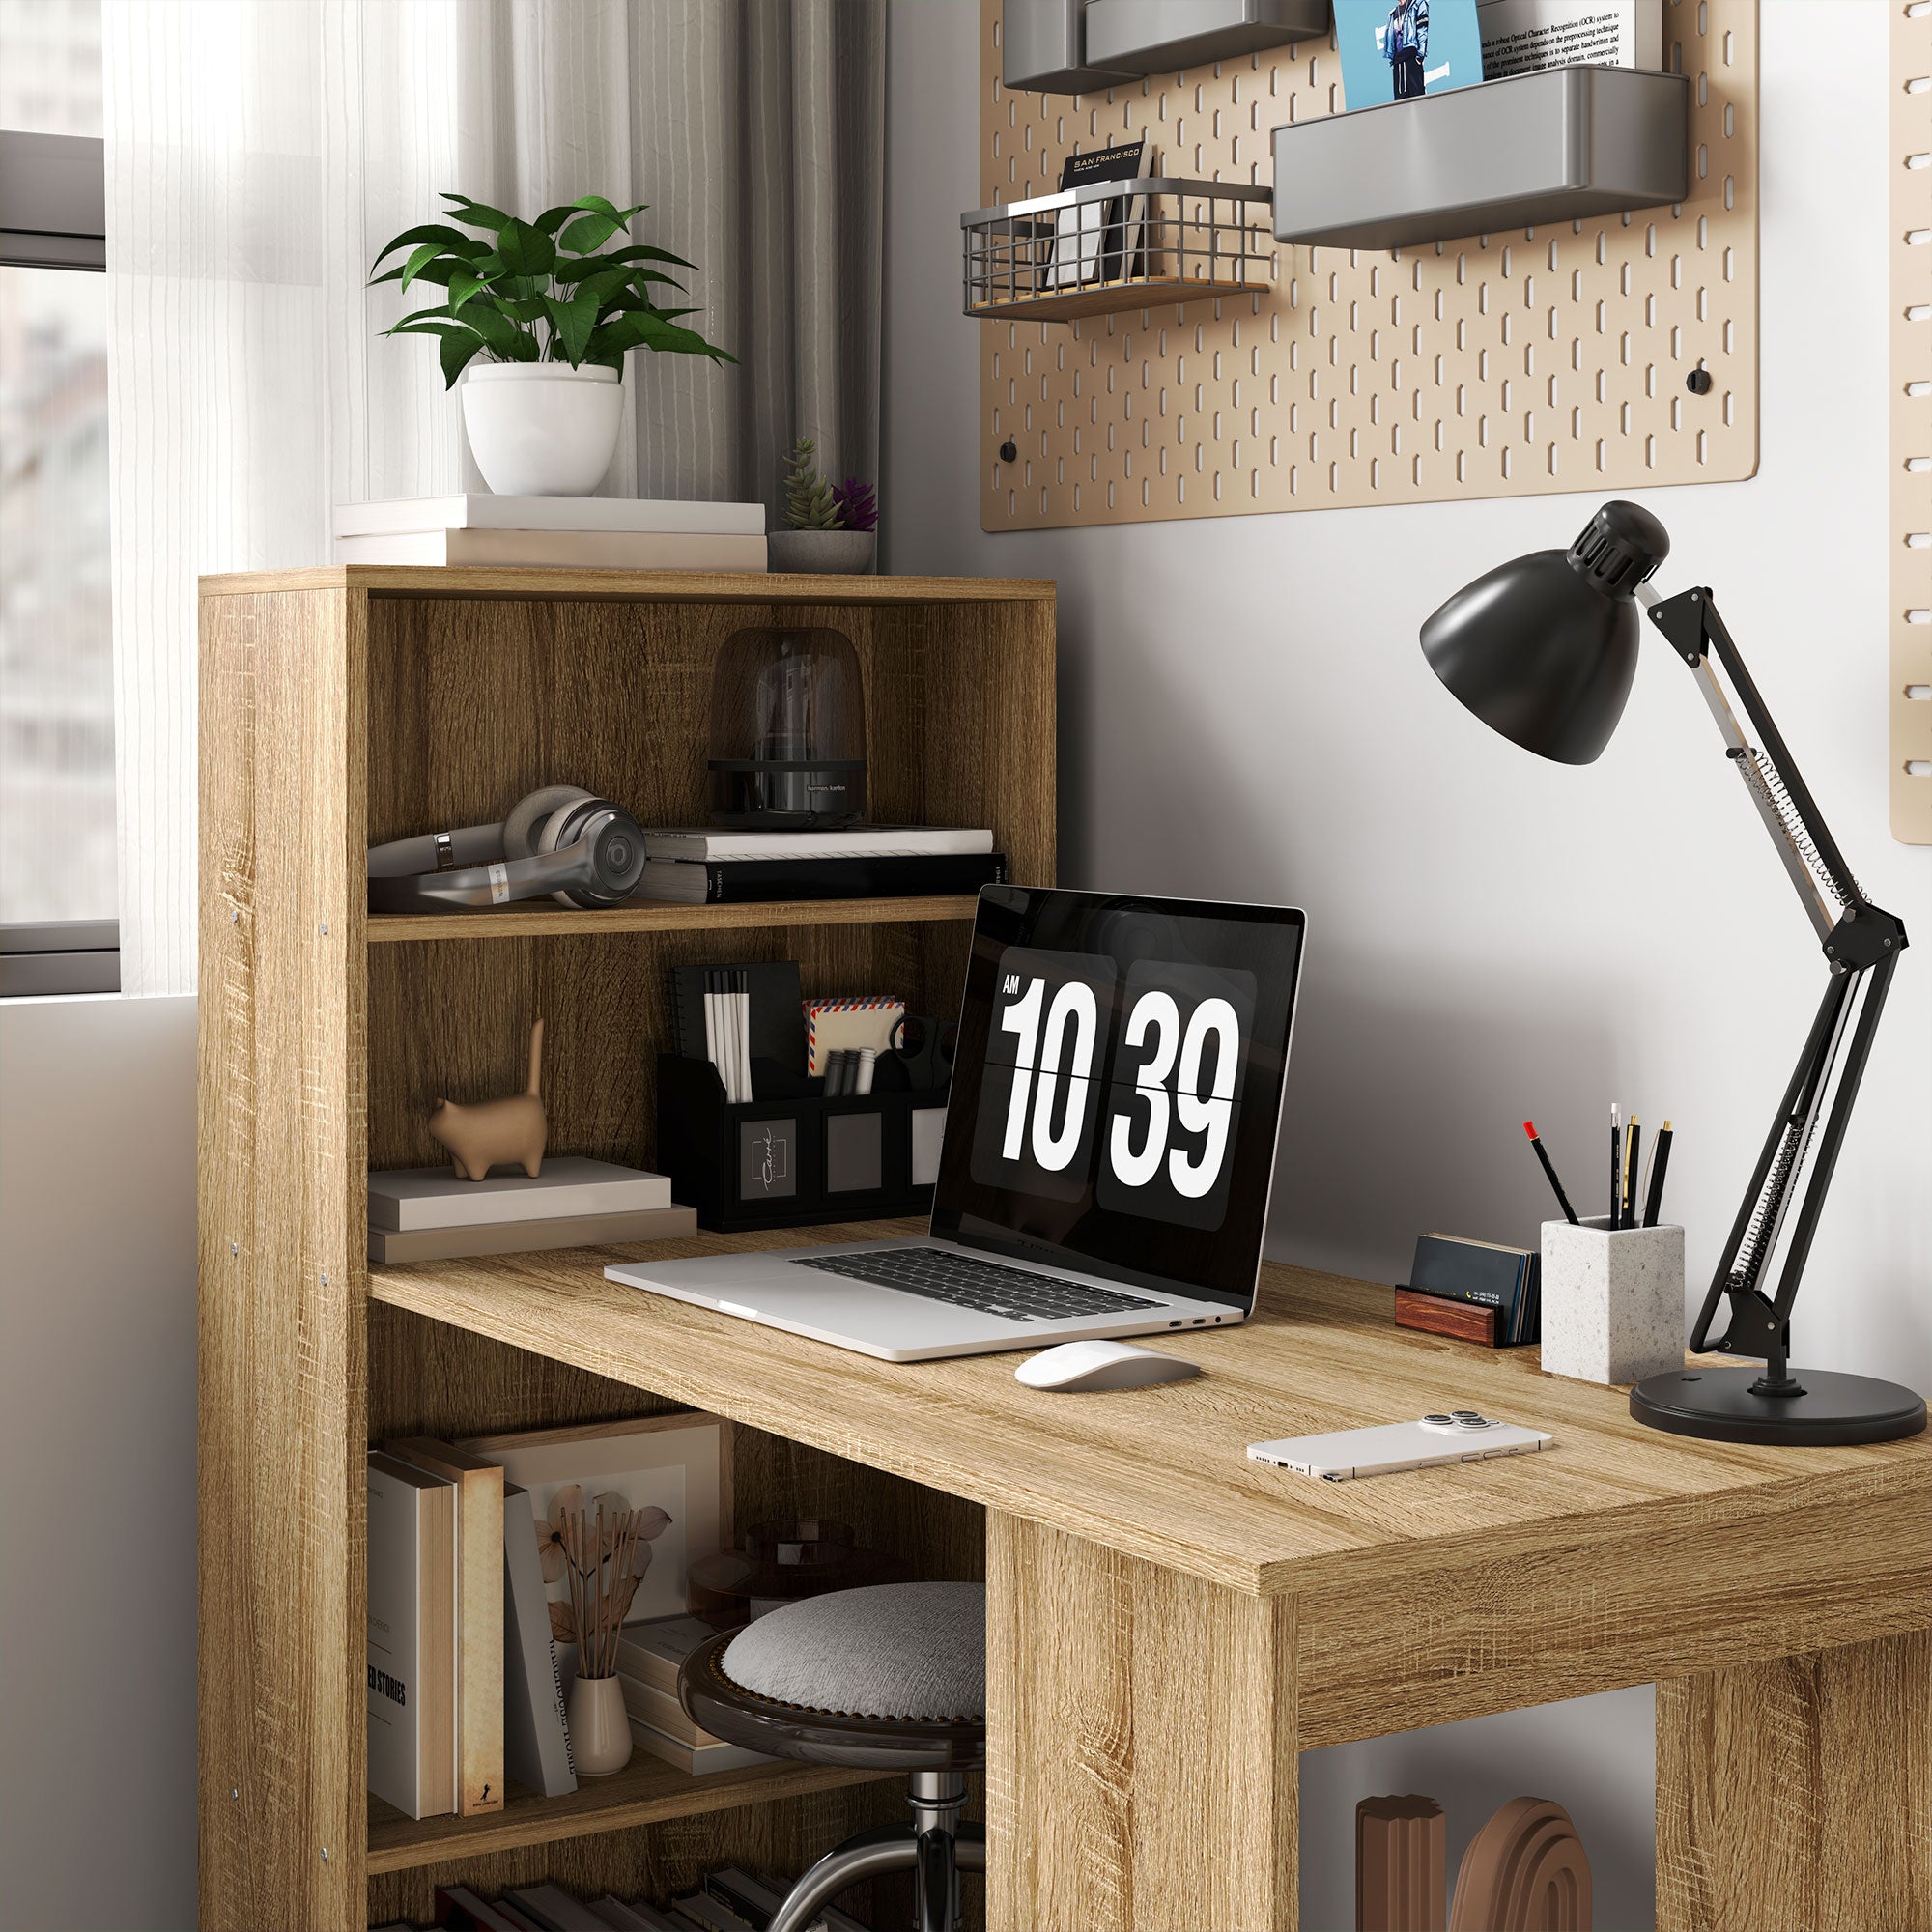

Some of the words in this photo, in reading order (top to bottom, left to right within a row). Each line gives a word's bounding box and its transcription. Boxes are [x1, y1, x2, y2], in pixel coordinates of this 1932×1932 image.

[1501, 46, 1513, 55] OCR
[1514, 44, 1529, 54] system
[1530, 39, 1548, 50] depends
[1563, 29, 1595, 43] preprocessing
[1596, 24, 1619, 34] technique
[1510, 31, 1527, 43] Optical
[1528, 28, 1549, 38] Character
[1551, 21, 1578, 32] Recognition
[1579, 16, 1595, 27] (OCR)
[1596, 14, 1613, 24] system
[1501, 56, 1523, 69] prominent
[1524, 50, 1548, 61] techniques
[1561, 44, 1580, 55] separate
[1581, 38, 1609, 49] handwritten
[1610, 33, 1619, 43] and
[1547, 57, 1566, 68] analysis
[1587, 46, 1619, 59] commercially
[1073, 158, 1094, 169] SAN
[1095, 148, 1140, 163] FRANCISCO
[1002, 973, 1020, 996] AM
[1000, 978, 1097, 1174] 10
[1110, 990, 1240, 1199] 39
[377, 1670, 406, 1707] STORIES
